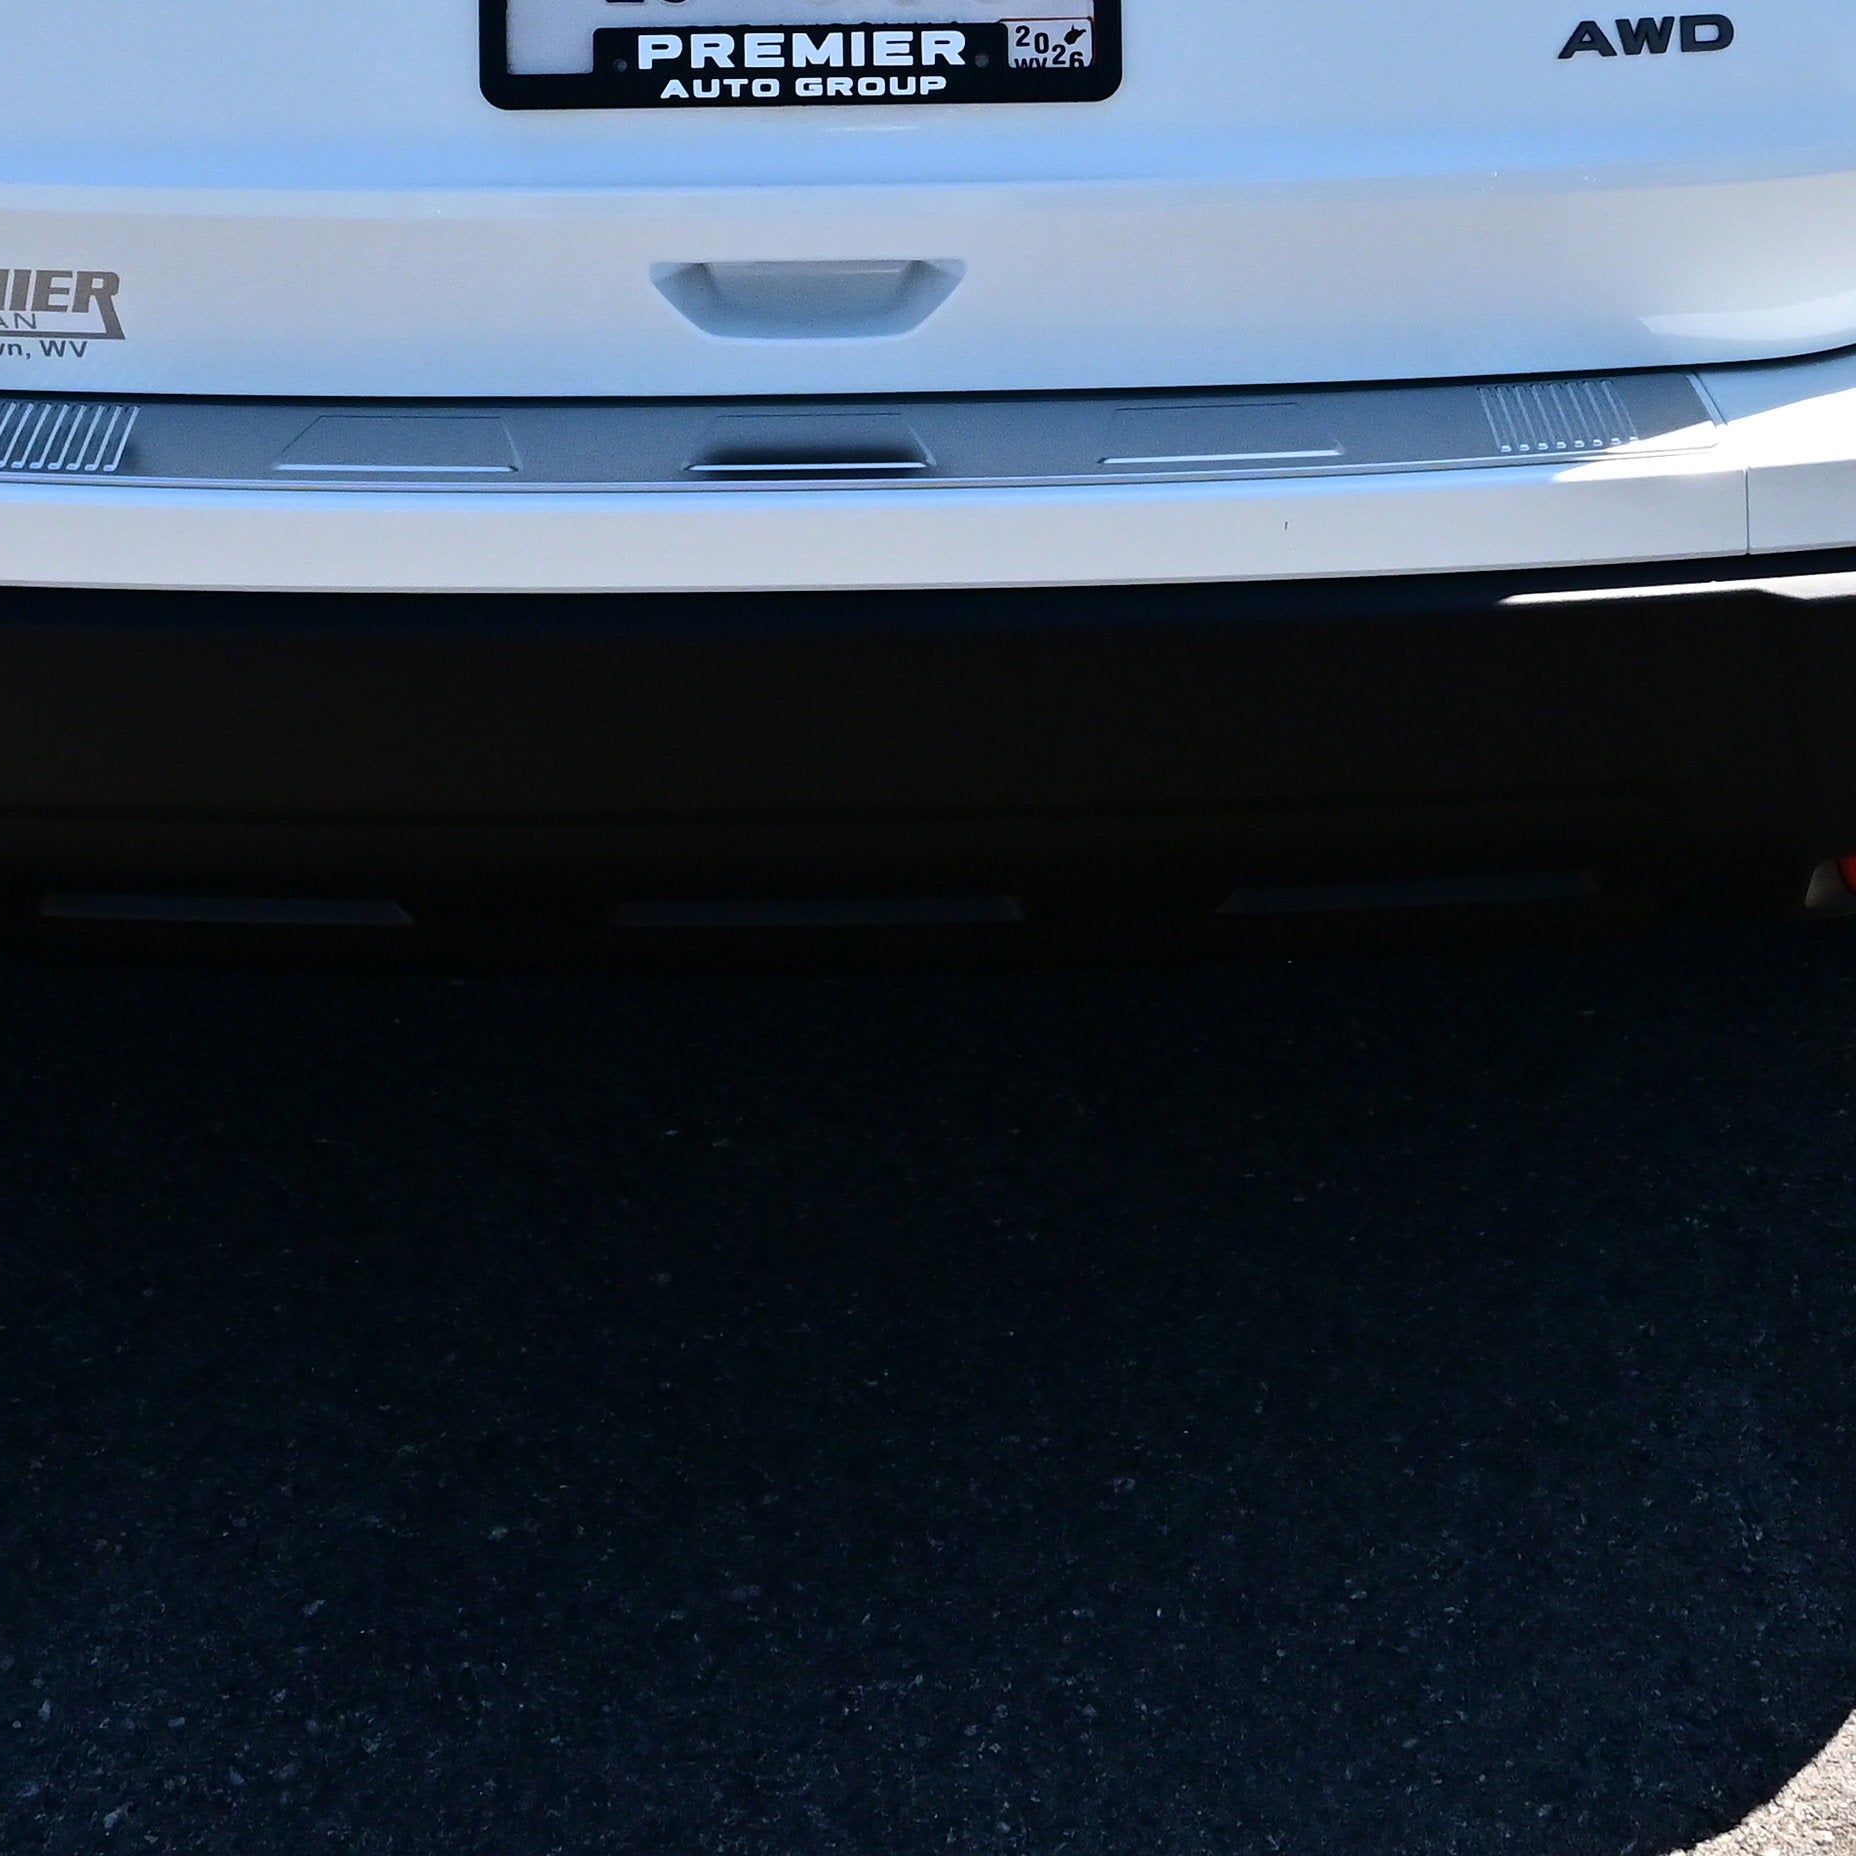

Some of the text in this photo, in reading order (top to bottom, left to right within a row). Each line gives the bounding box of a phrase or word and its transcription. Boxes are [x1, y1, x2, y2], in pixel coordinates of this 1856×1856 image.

[637, 29, 967, 70] PREMIER
[1557, 13, 1735, 59] AWD
[660, 75, 947, 99] AUTO GROUP
[40, 340, 88, 358] WV
